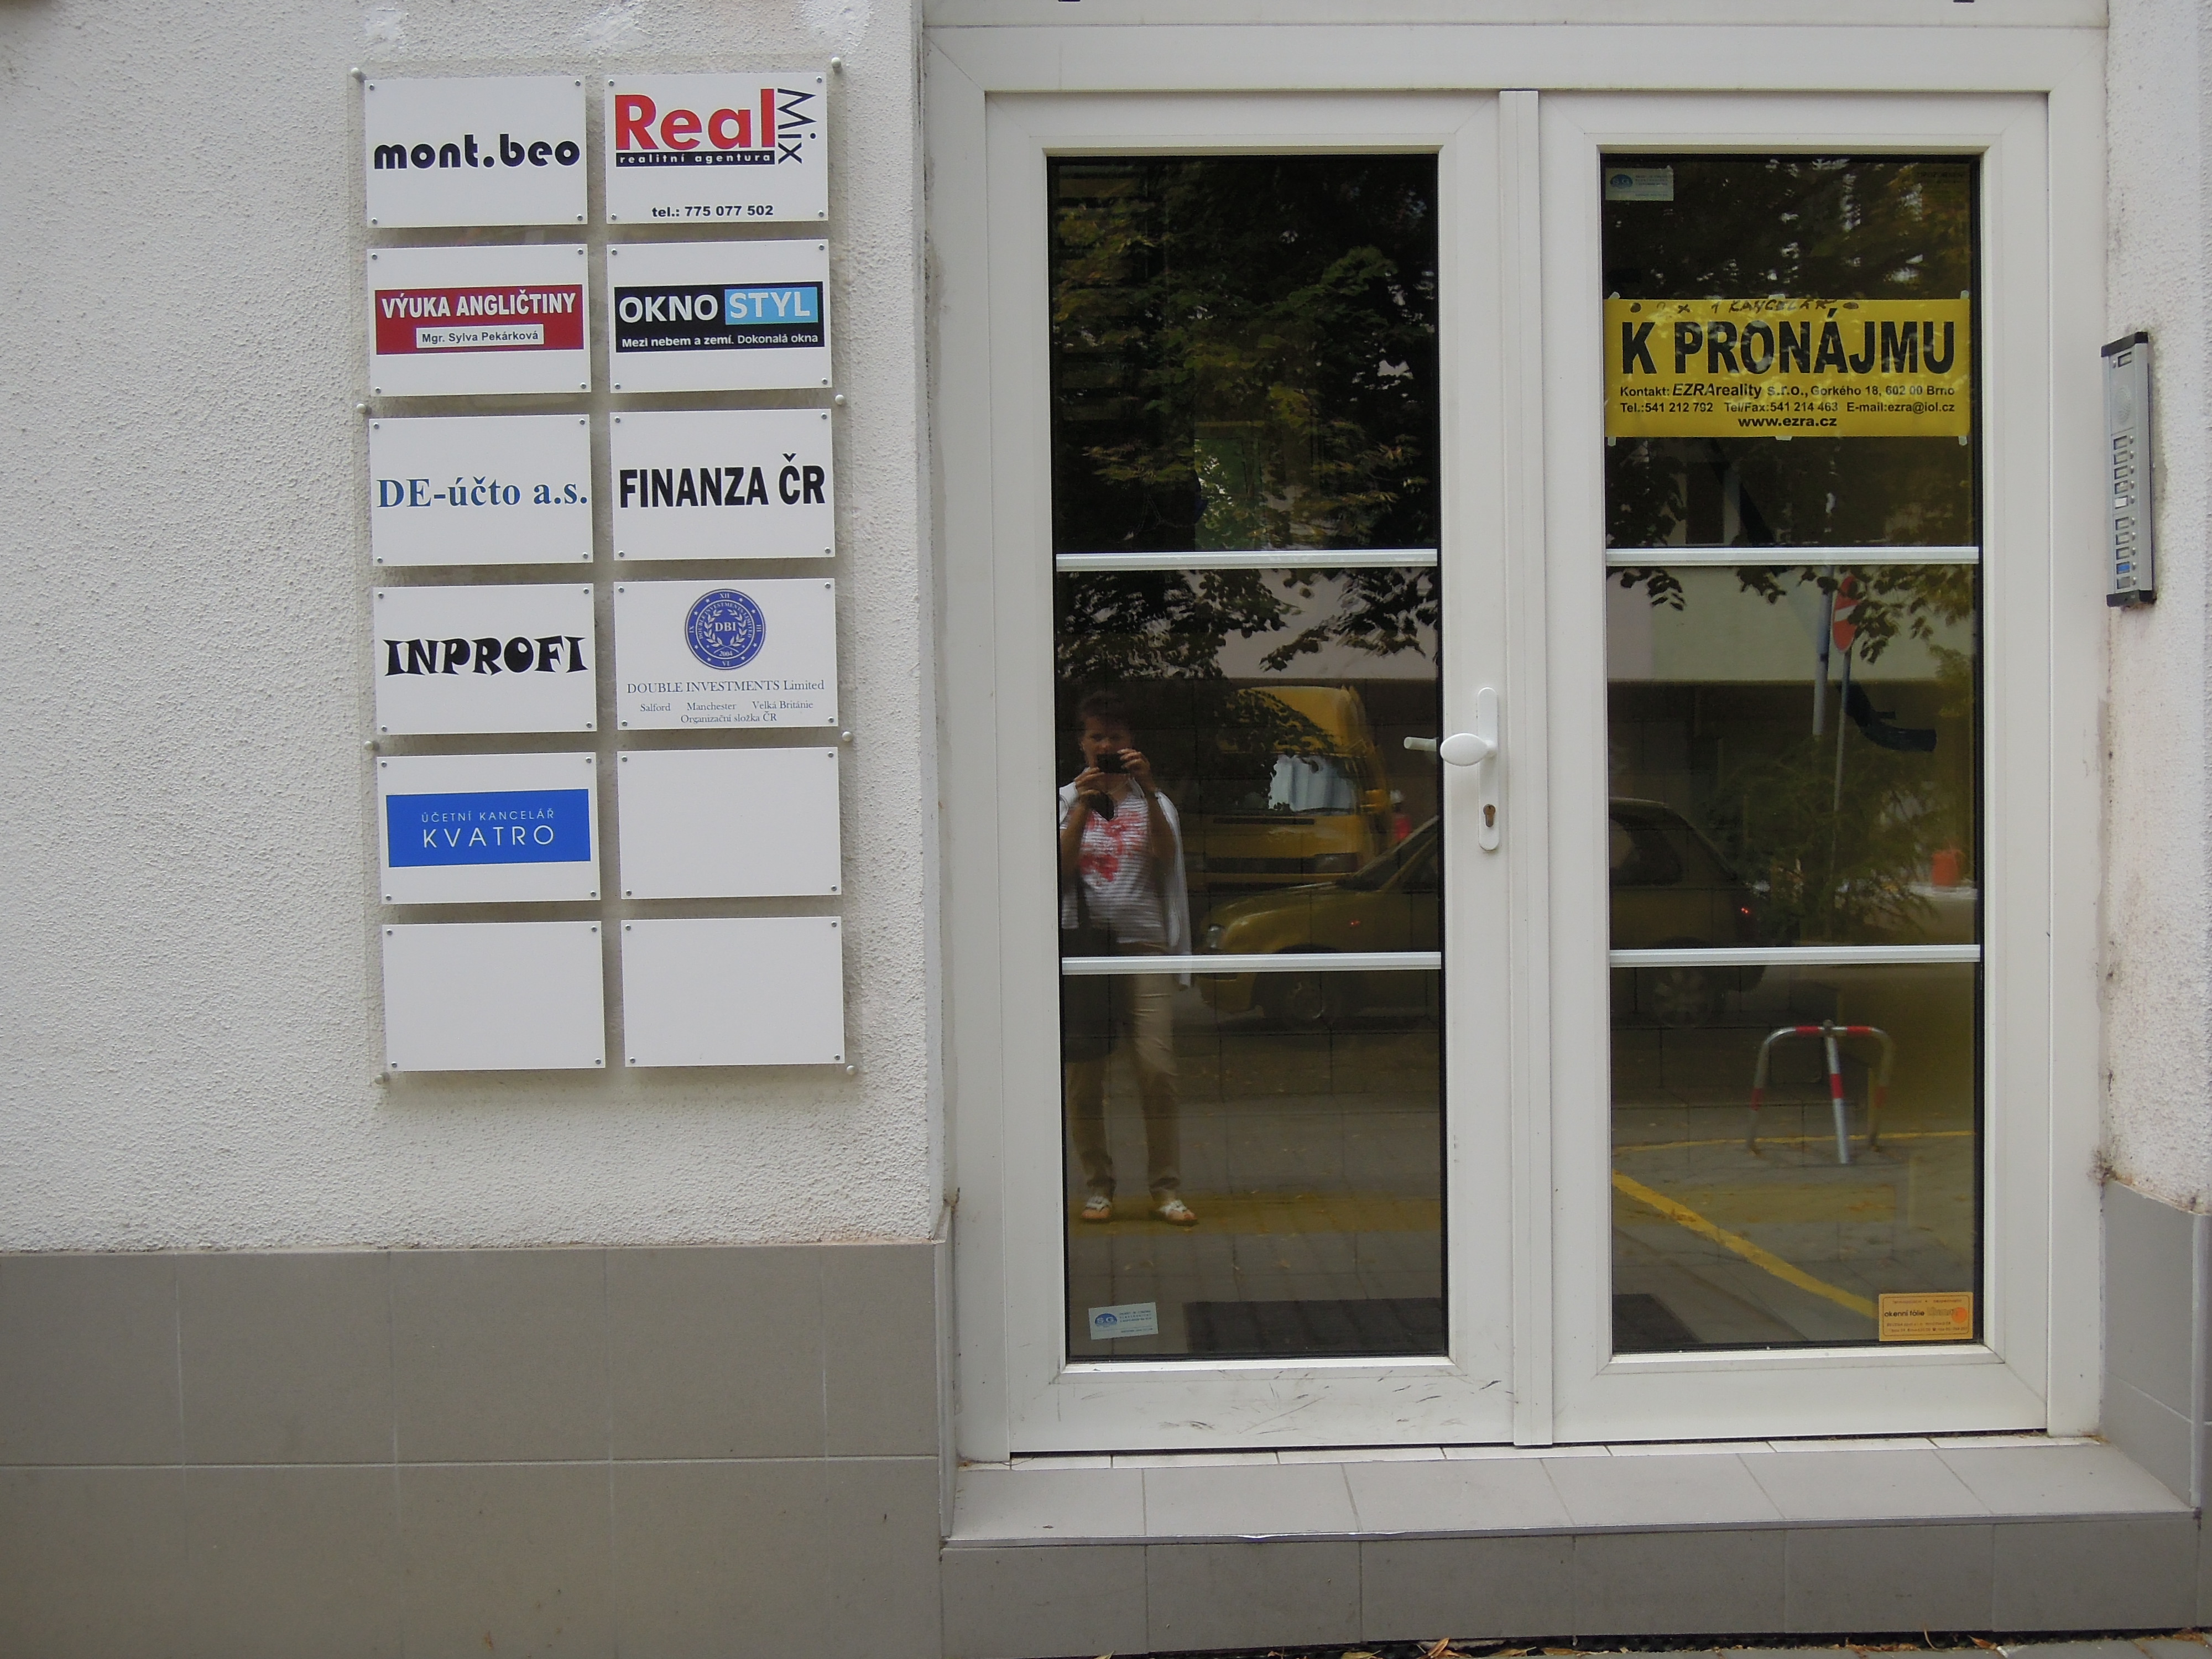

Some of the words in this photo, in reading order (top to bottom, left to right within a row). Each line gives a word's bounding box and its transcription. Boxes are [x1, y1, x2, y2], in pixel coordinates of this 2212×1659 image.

[615, 88, 775, 150] Real
[777, 88, 817, 164] Mix
[374, 133, 580, 169] mont.beo
[619, 154, 685, 164] realitní
[695, 154, 770, 164] agentura
[652, 207, 679, 217] tel.:
[685, 206, 711, 217] 775
[716, 206, 741, 216] 077
[747, 205, 773, 216] 502
[382, 293, 451, 318] VÝUKA
[457, 289, 576, 316] ANGLIČTINY
[619, 295, 718, 324] OKNO
[729, 291, 810, 318] STYL
[422, 333, 445, 344] Mgr.
[448, 332, 478, 343] Sylva
[482, 330, 539, 341] Pekárková
[622, 337, 648, 347] Mezi
[651, 336, 691, 347] nebem
[694, 337, 701, 346] a
[704, 335, 734, 345] zemí.
[738, 334, 788, 344] Dokonalá
[791, 334, 818, 343] okna
[1621, 322, 1657, 374] K
[1674, 309, 1954, 374] PRONÁJMU
[1620, 387, 1670, 397] Kontakt:
[1672, 383, 1761, 399] EZRAreality
[1767, 385, 1808, 397] s.r.o.,
[1811, 386, 1861, 395] Gorkého
[1866, 386, 1881, 396] 18,
[1886, 386, 1905, 395] 602
[1910, 386, 1922, 395] 00
[1927, 386, 1954, 395] Brno
[1620, 402, 1664, 412] Tel.:541
[1669, 403, 1689, 412] 212
[1694, 402, 1713, 412] 792
[1794, 402, 1813, 411] 214
[1818, 402, 1838, 411] 463
[1847, 401, 1954, 414] E-mail:ezra@iol.cz
[1739, 417, 1837, 426] www.ezra.cz
[619, 466, 769, 508] FINANZA
[779, 453, 825, 505] ČR
[377, 476, 520, 508] DE-účto
[533, 482, 587, 505] a.s.
[715, 622, 736, 632] DBI
[383, 637, 588, 677] INPROFI
[627, 682, 682, 693] DOUBLE
[686, 681, 780, 692] INVESTMENTS
[784, 680, 824, 690] Limited
[640, 703, 671, 712] Salford
[687, 702, 737, 711] Manchester
[753, 701, 776, 709] Velká
[779, 700, 813, 708] Británie
[681, 714, 732, 724] Organizační
[734, 713, 760, 722] složka
[763, 711, 776, 722] ČR
[422, 811, 472, 822] ÚČETNÍ
[480, 808, 555, 821] KANCELÁŘ
[423, 825, 554, 848] KVATRO
